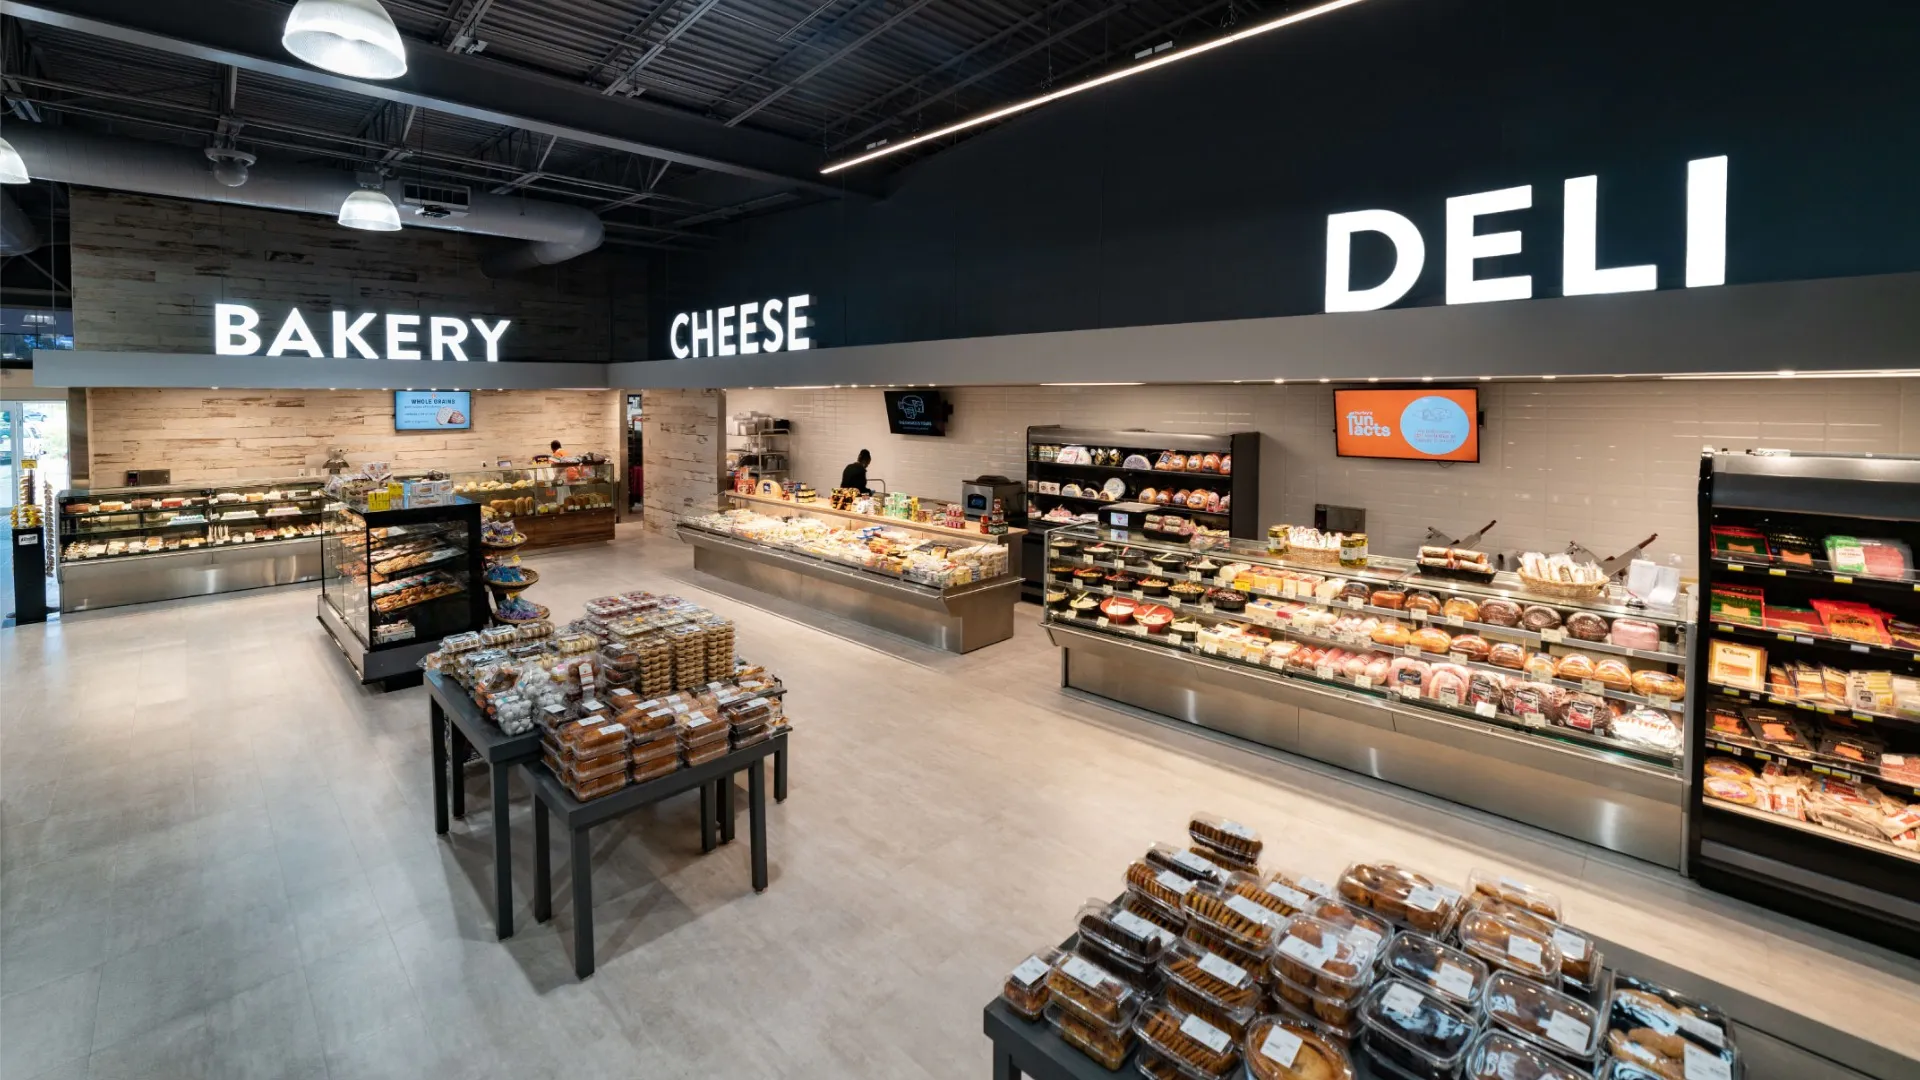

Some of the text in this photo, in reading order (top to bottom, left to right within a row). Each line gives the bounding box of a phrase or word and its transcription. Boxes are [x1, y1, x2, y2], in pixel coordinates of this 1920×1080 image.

[1324, 154, 1729, 314] DELI
[214, 302, 511, 362] BAKERY
[670, 293, 812, 360] CHEESE
